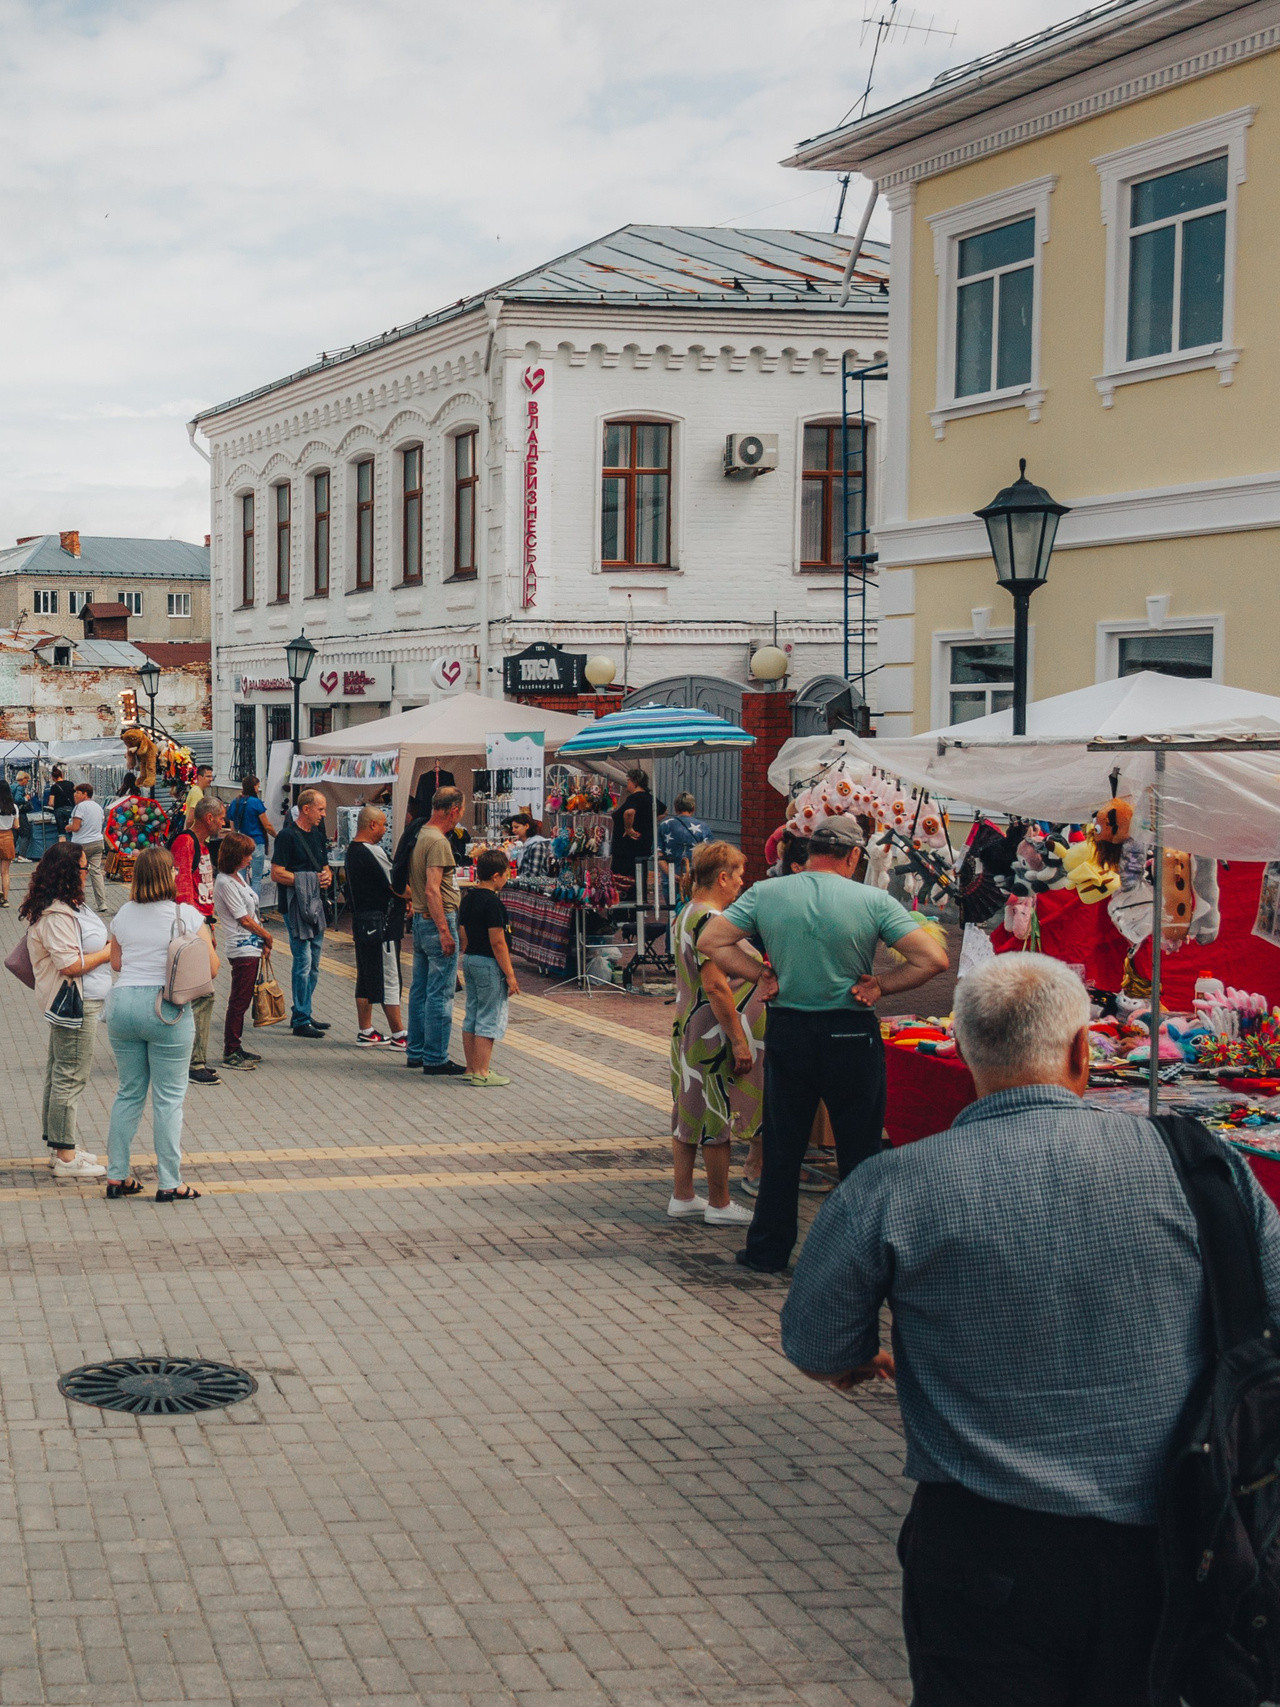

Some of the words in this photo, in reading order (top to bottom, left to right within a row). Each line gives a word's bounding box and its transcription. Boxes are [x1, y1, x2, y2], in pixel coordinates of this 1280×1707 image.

[524, 401, 539, 607] ВЛАДБИЗНЕСБАНК
[343, 670, 366, 678] ВЛАД
[343, 677, 376, 686] БИЗНЕС
[343, 685, 366, 695] БАНК
